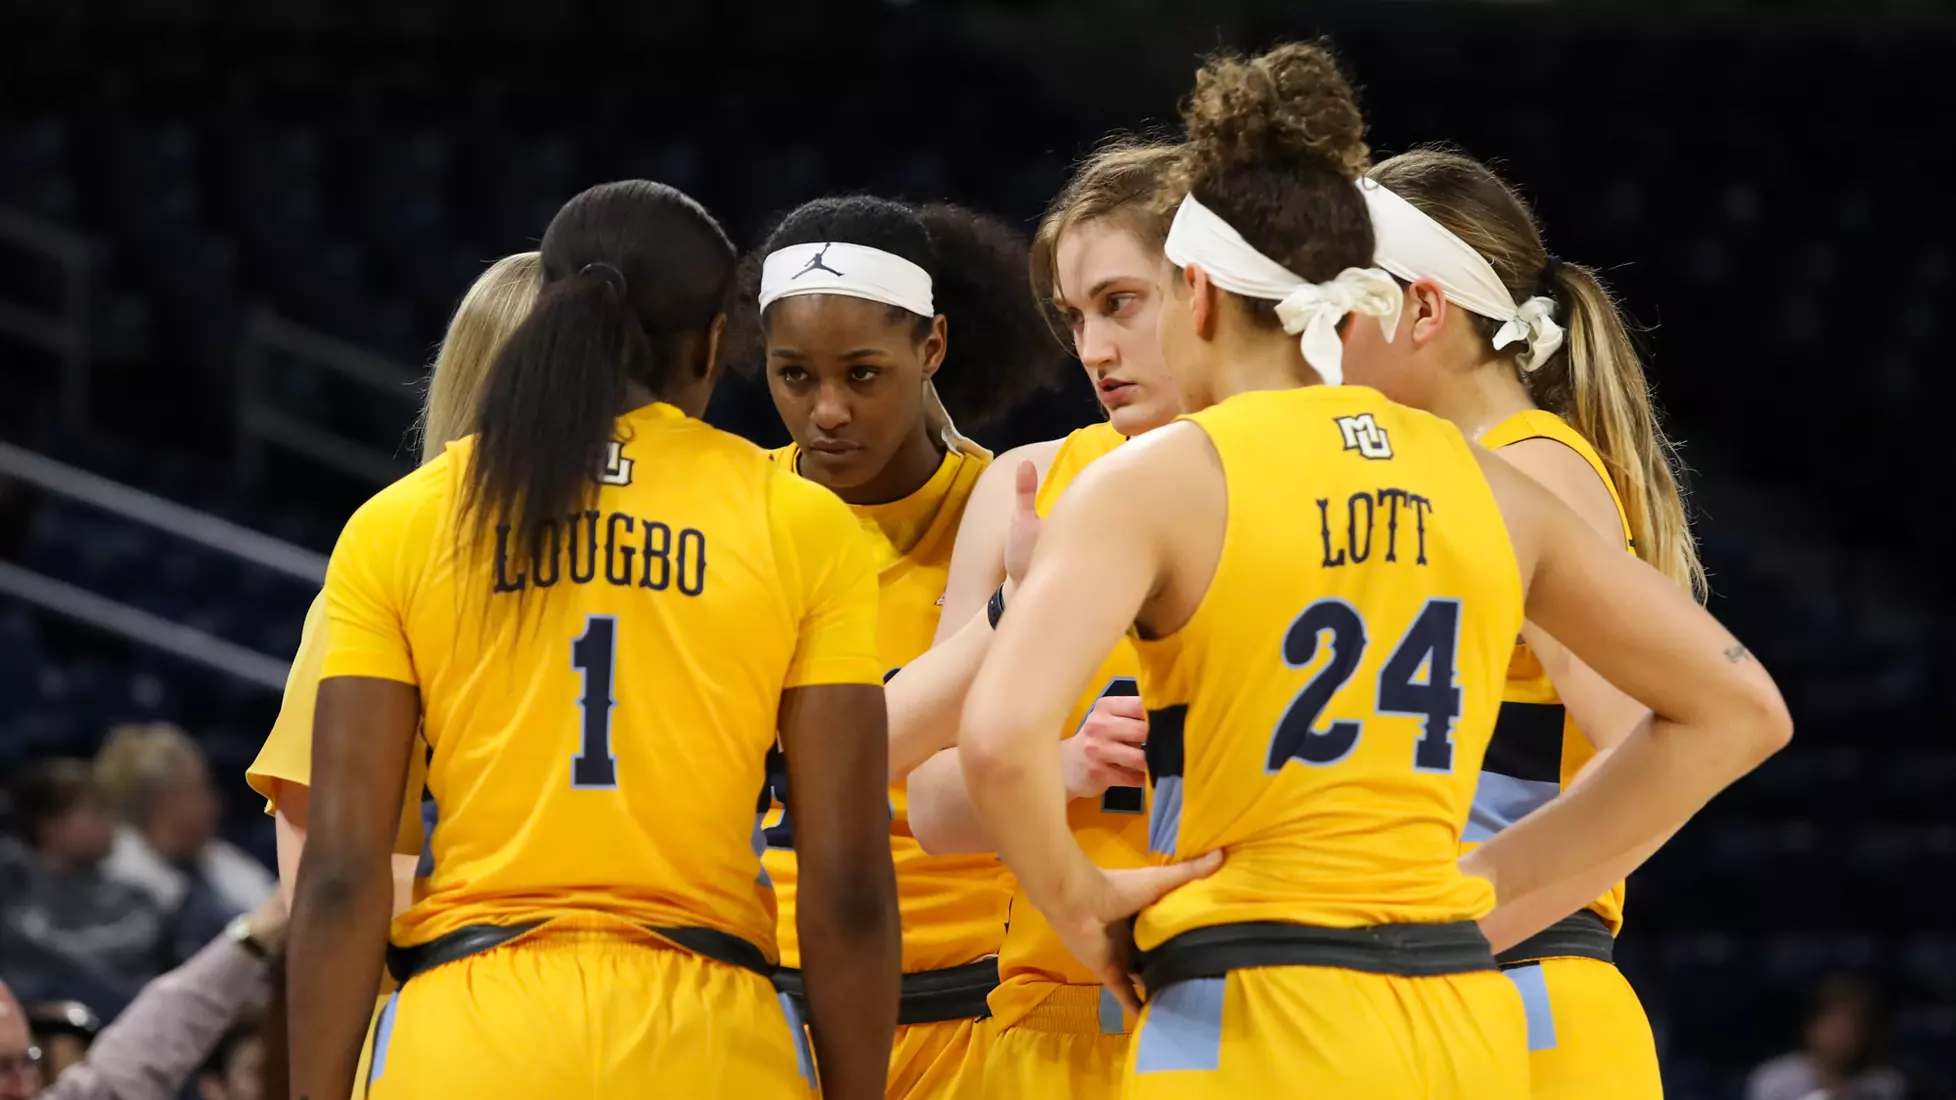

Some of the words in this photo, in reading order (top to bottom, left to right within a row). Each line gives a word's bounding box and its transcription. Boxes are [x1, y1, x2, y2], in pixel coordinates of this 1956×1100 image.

[1334, 413, 1394, 460] MU
[493, 509, 707, 597] LOUGBO
[1316, 488, 1433, 568] LOTT
[570, 613, 618, 790] 1
[1263, 596, 1463, 775] 24
